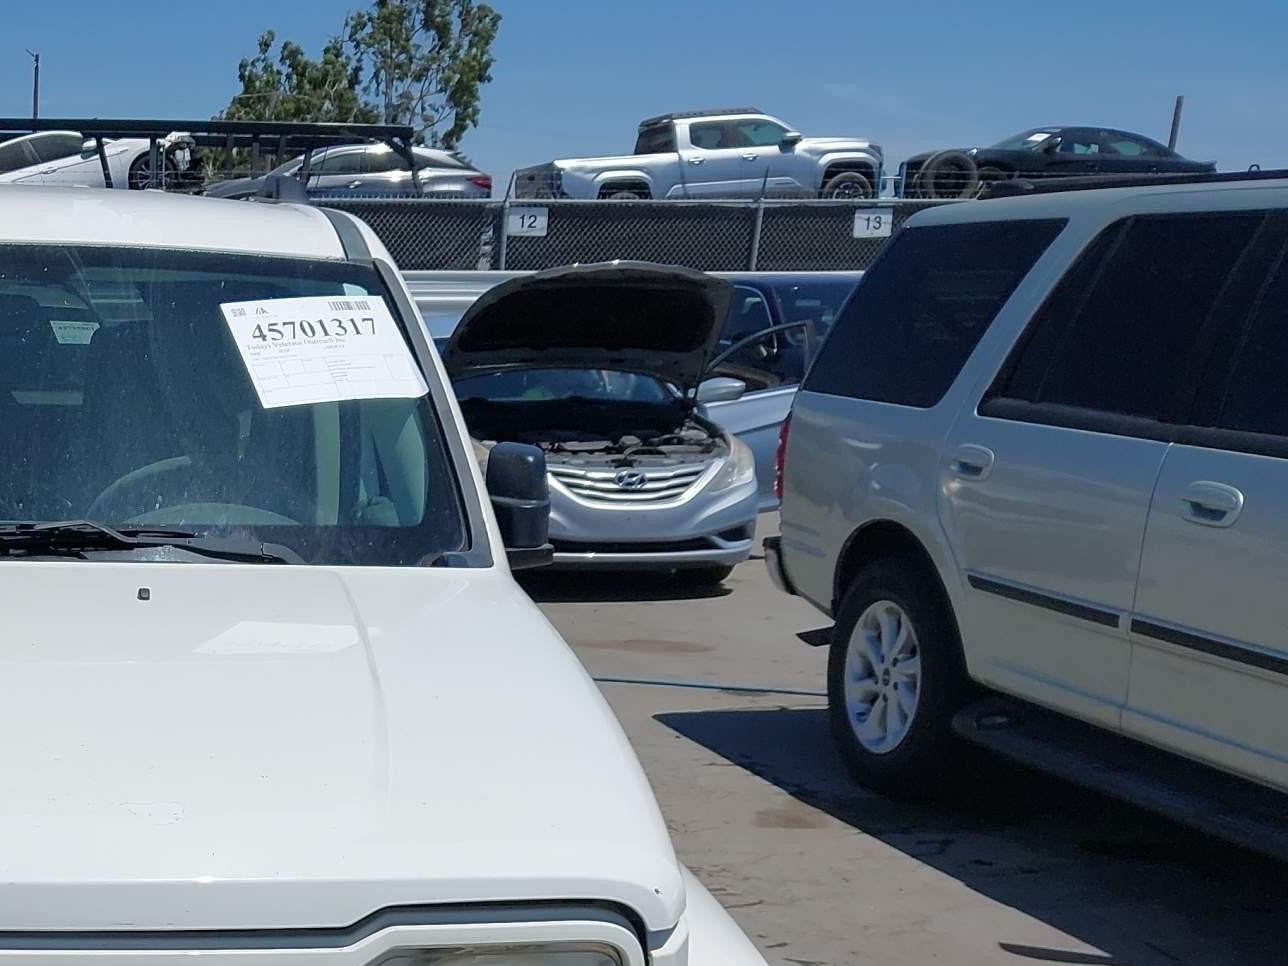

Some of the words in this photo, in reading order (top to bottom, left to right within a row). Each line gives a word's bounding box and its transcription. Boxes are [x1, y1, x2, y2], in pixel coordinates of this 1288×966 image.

[519, 214, 537, 229] 12
[863, 215, 882, 230] 13
[252, 317, 376, 342] 45701317
